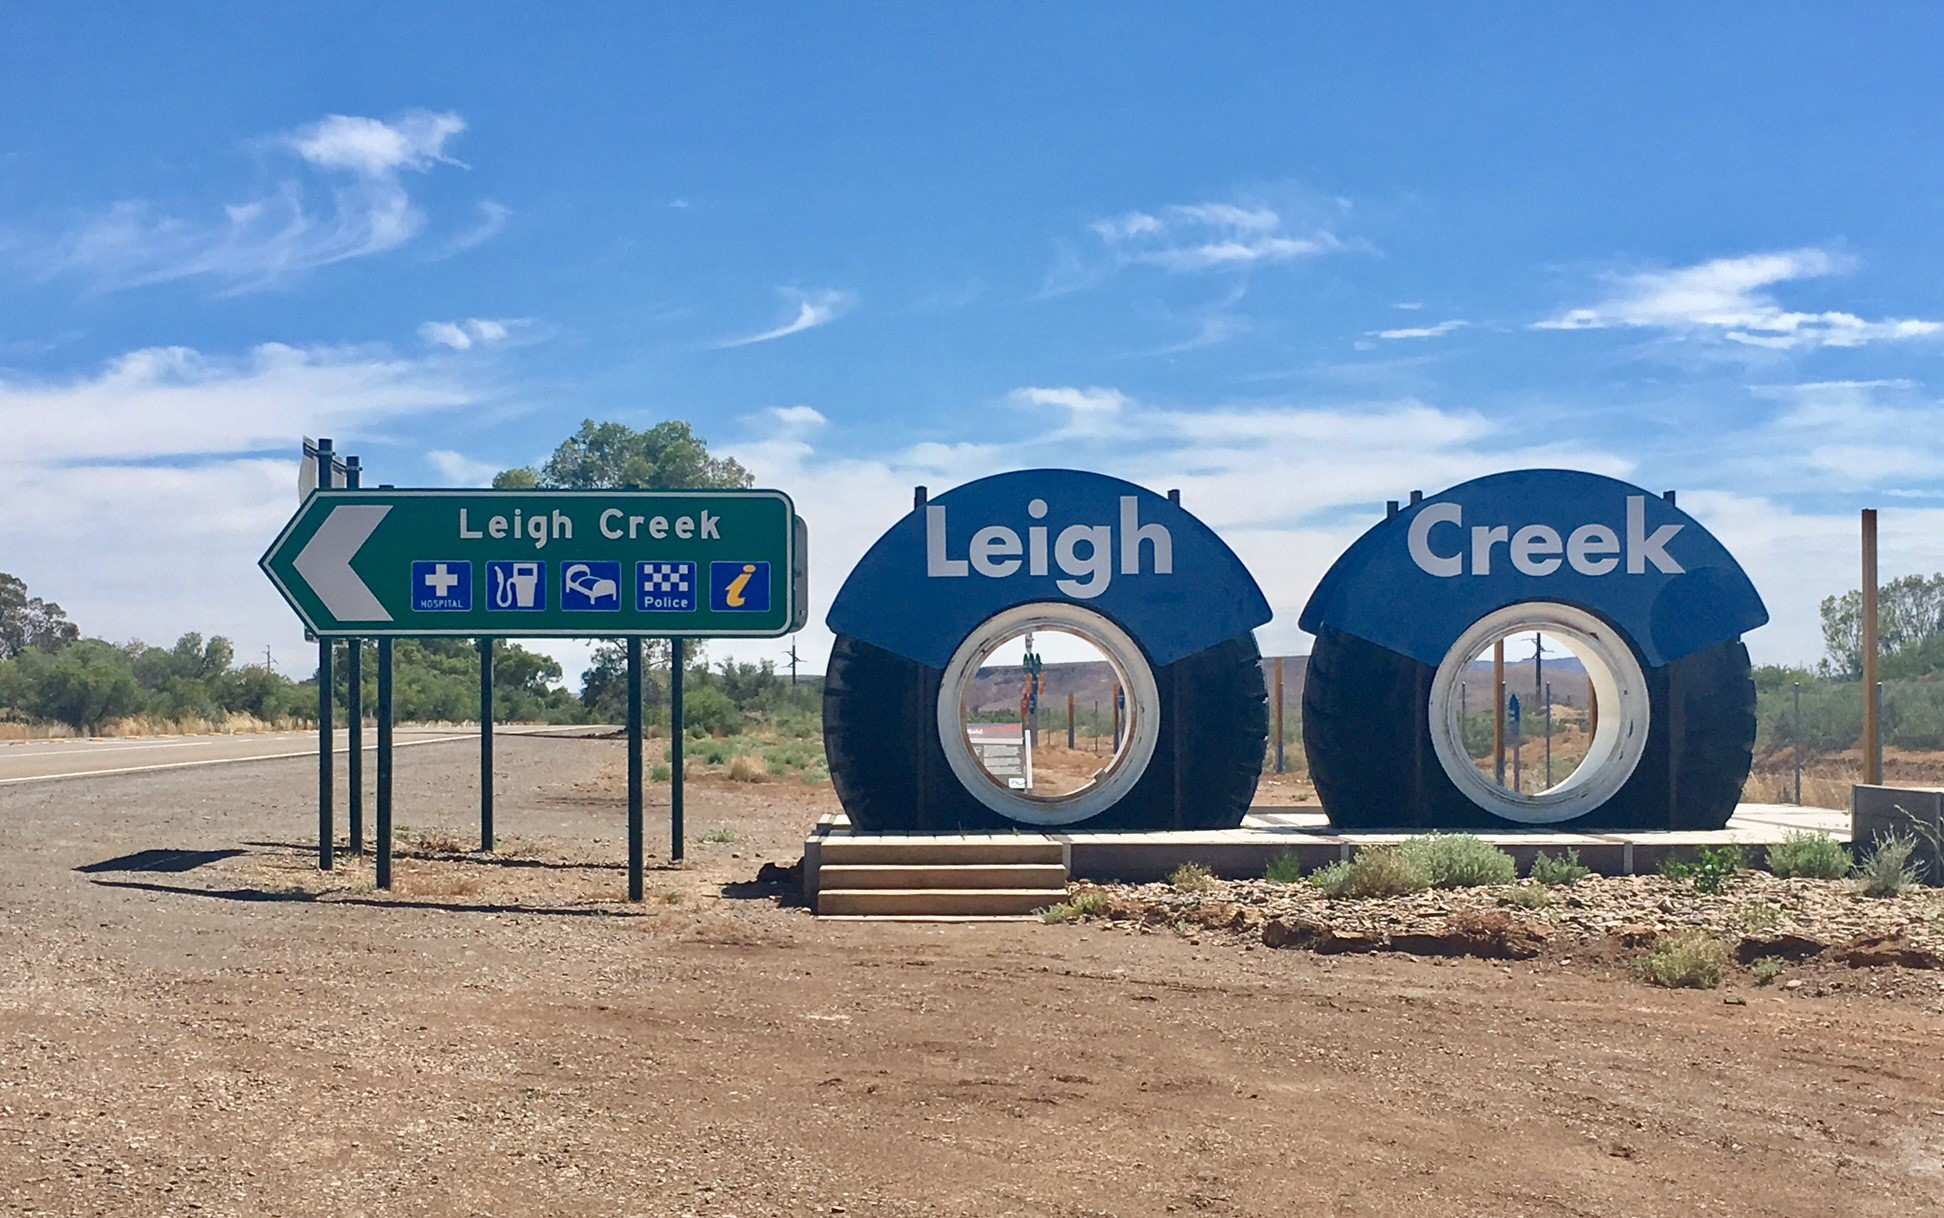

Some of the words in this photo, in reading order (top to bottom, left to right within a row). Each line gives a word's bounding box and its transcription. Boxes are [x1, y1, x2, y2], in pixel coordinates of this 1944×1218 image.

[460, 508, 572, 549] Leigh
[599, 508, 720, 539] Creek
[925, 495, 1174, 598] Leigh
[1407, 495, 1686, 577] Creek
[420, 599, 464, 609] HOSPITAL
[644, 596, 689, 608] Police
